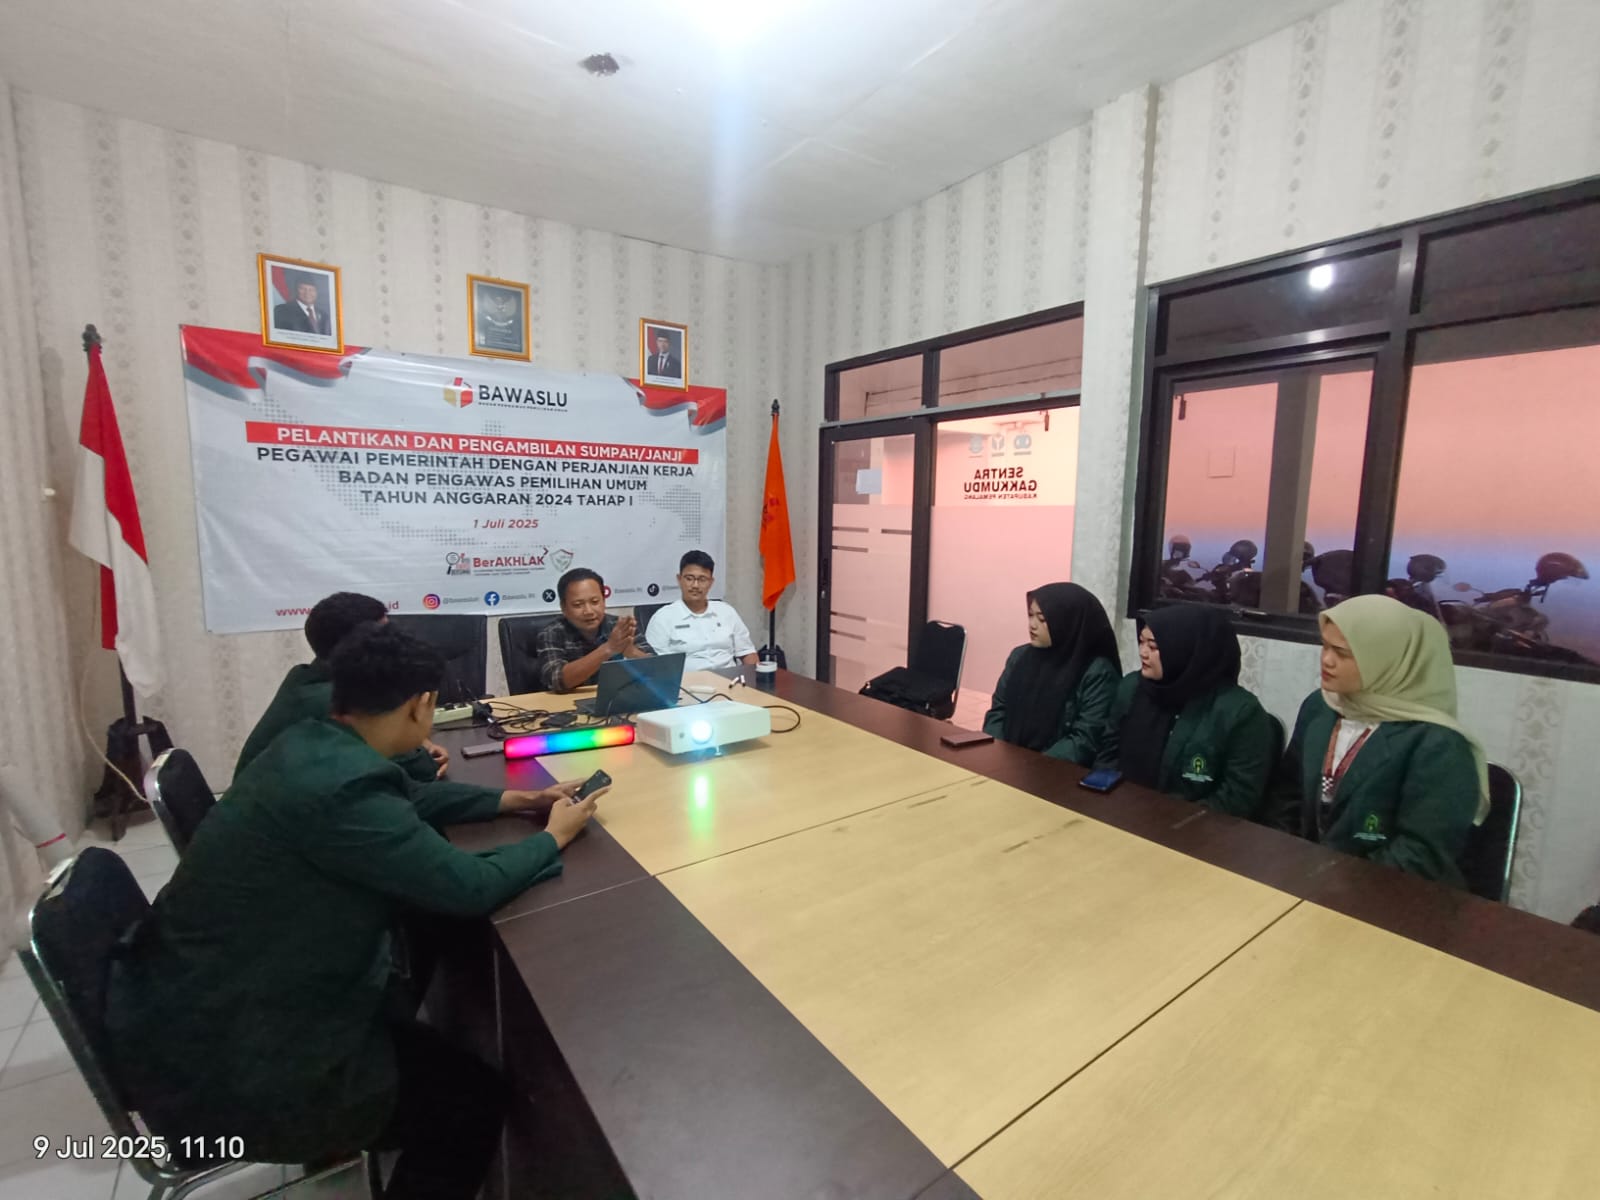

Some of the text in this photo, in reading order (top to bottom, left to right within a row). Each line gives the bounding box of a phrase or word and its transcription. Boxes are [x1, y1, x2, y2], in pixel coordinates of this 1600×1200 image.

[478, 384, 567, 407] BAWASLU
[277, 427, 683, 462] PELANTIKAN DAN PENGAMBILAN SUMPAH/JANJI
[257, 447, 693, 477] PEGAWAI PEMERINTAH DENGAN PERJANJIAN KERJA
[338, 470, 647, 490] BADAN PENGAWAS PEMILIHAN UMUM
[360, 490, 633, 506] TAHUN ANGGARAN 2024 TAHAP I
[473, 519, 539, 529] 1 Juli 2025
[472, 555, 545, 568] BerAKHLAK
